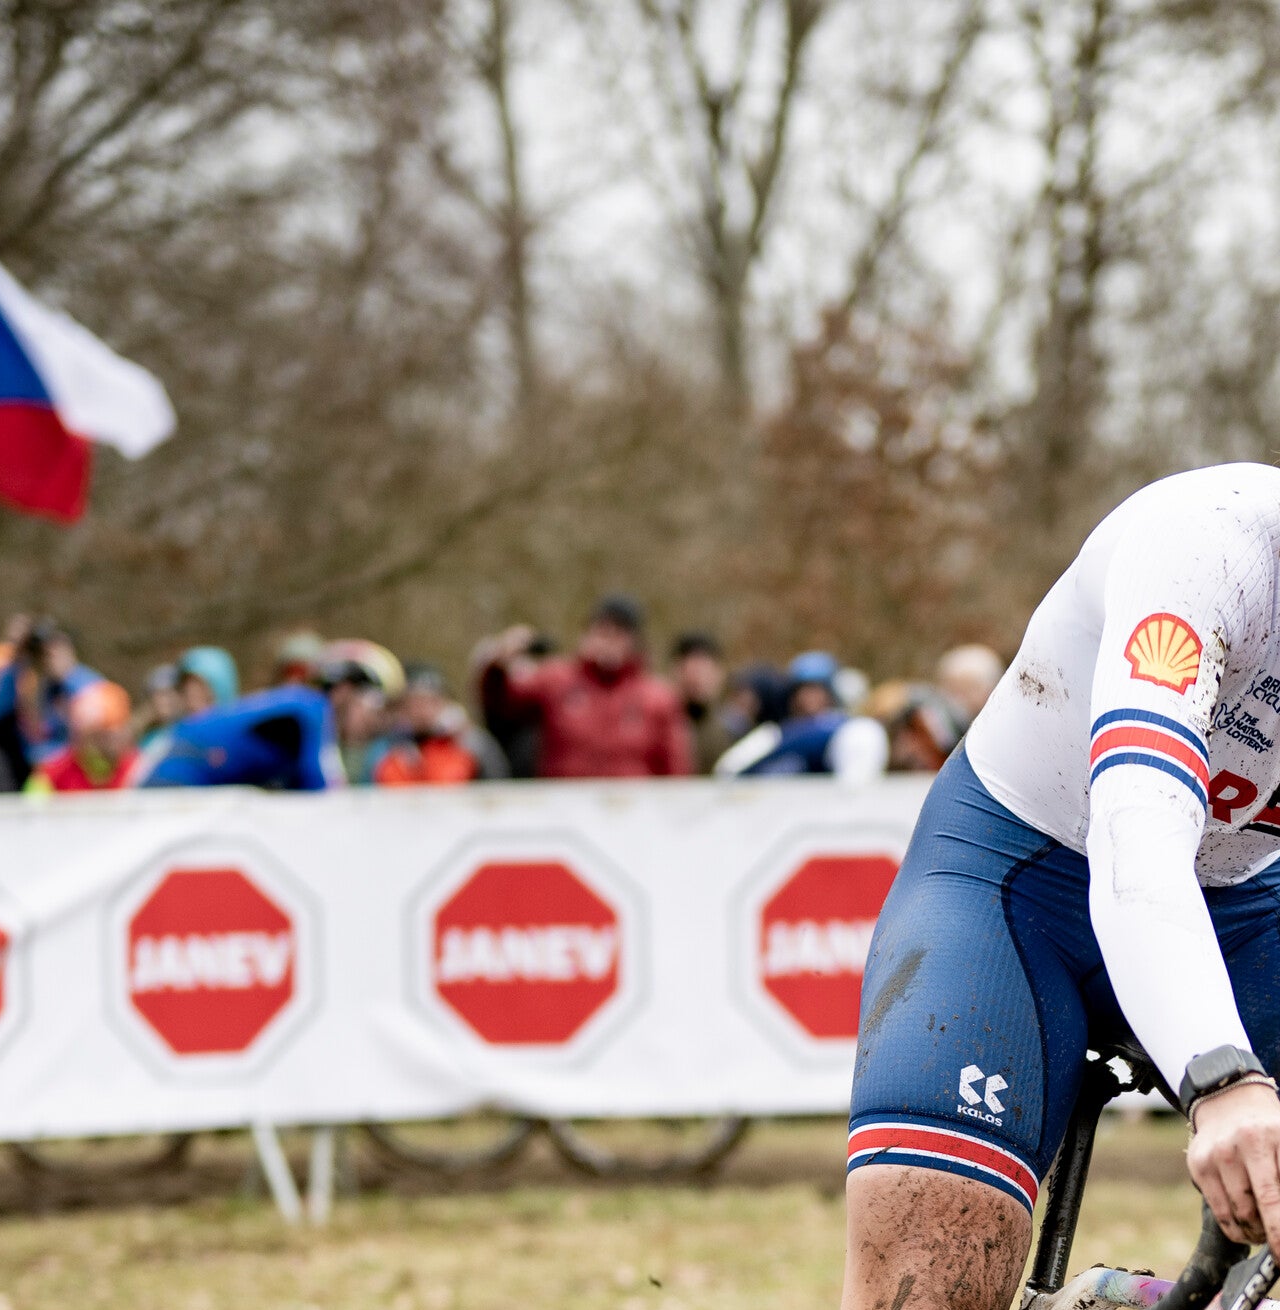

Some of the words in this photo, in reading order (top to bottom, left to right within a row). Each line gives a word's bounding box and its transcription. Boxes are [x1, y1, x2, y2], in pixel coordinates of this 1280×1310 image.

[1226, 727, 1269, 754] LOTTERY
[1240, 711, 1259, 727] THE
[132, 932, 294, 992] JANEV
[436, 923, 619, 983] JANEV
[765, 919, 877, 976] JAN
